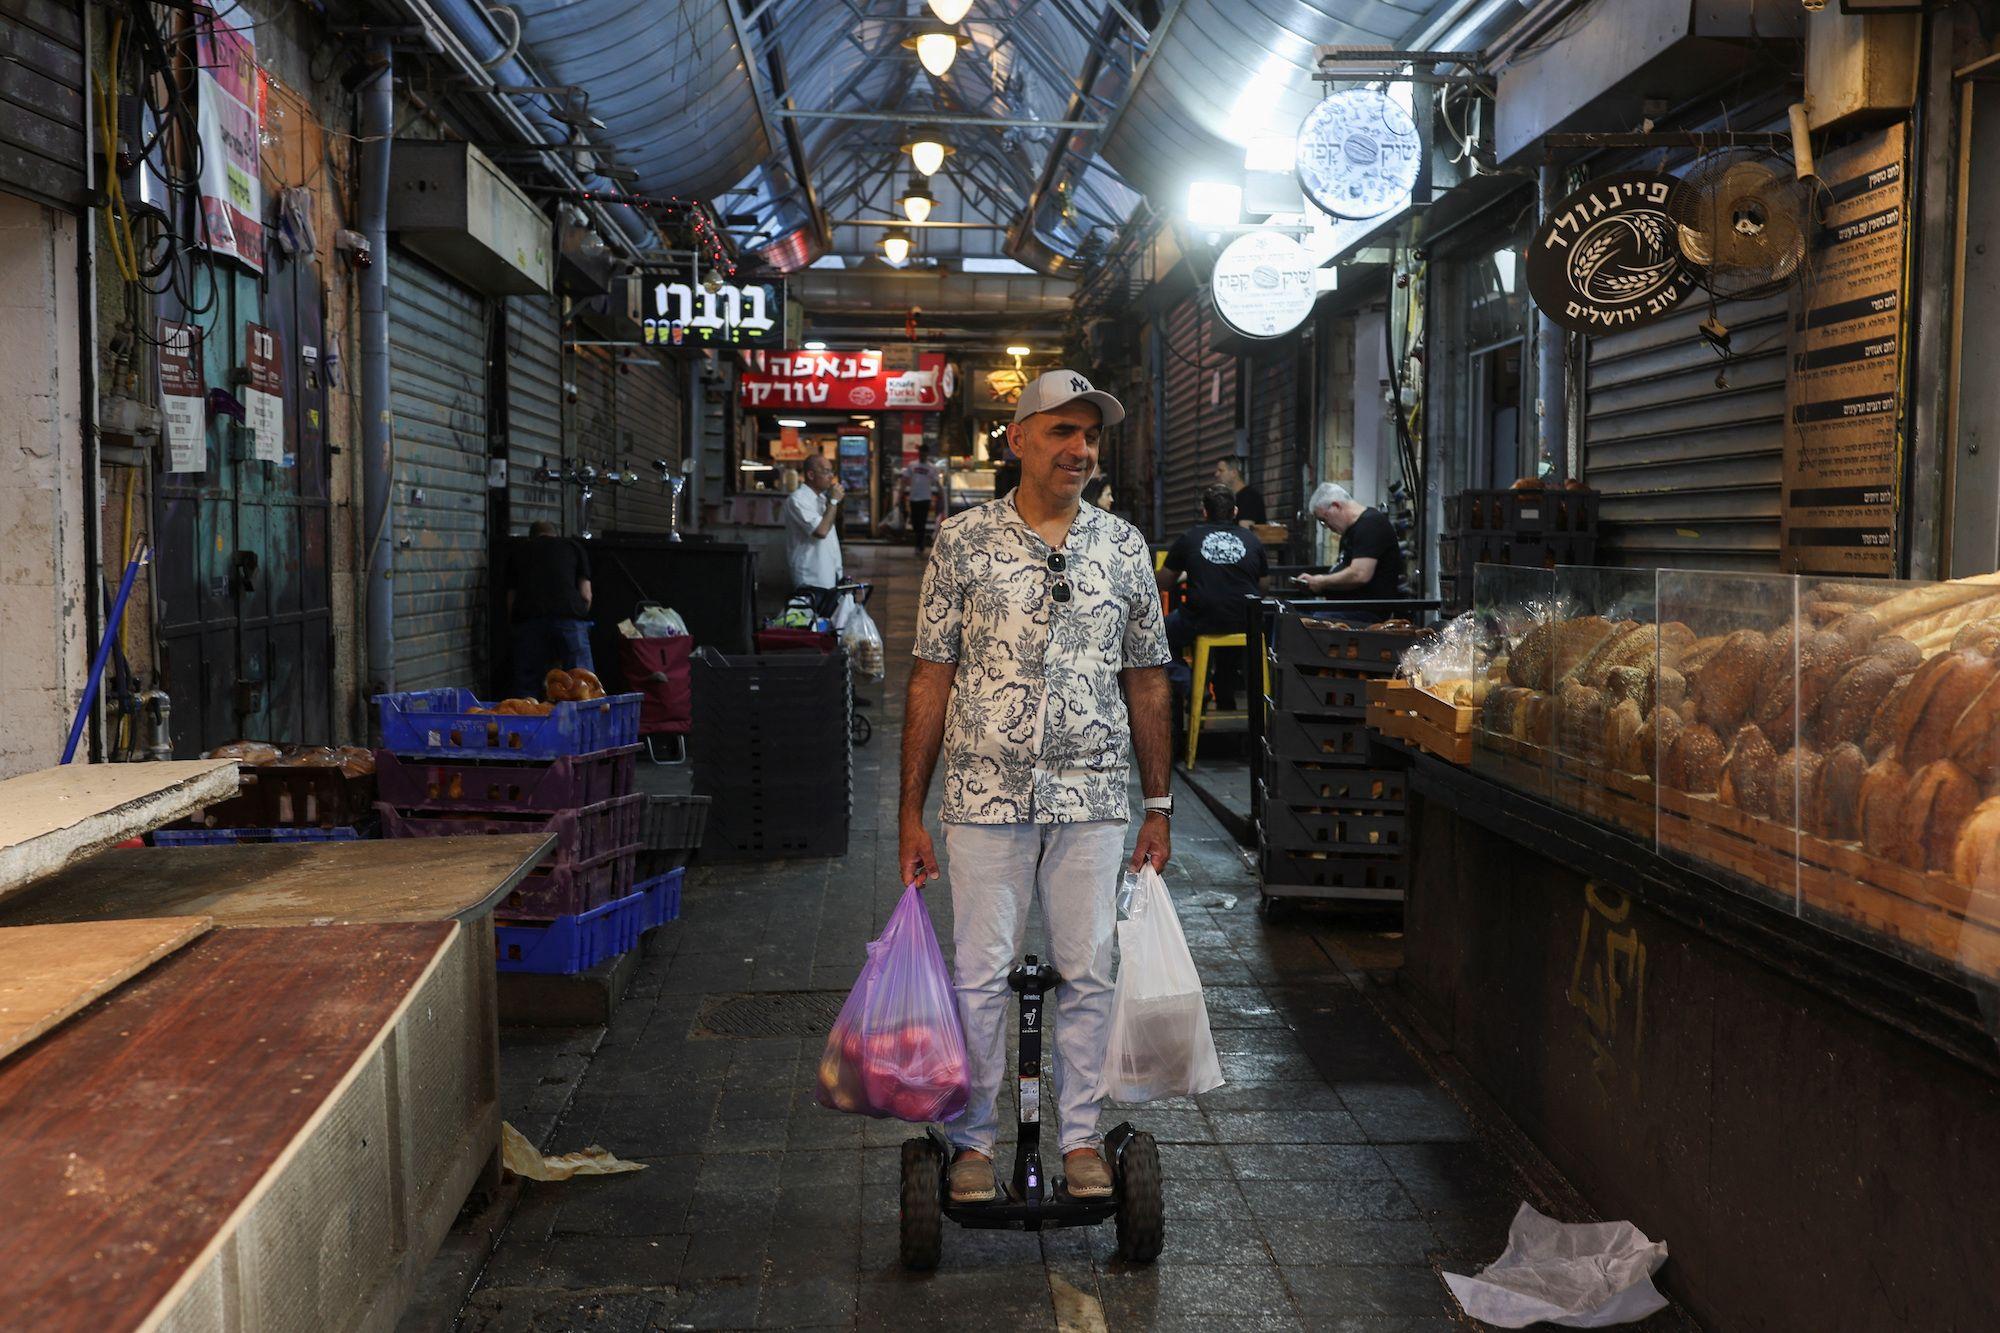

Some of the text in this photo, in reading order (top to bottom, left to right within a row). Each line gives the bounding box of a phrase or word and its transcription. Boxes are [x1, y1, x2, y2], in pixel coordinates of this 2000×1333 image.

[1544, 181, 1670, 250] פיינגולד
[1565, 285, 1678, 326] טוב ירושלים
[769, 355, 880, 378] כנאפה
[741, 380, 830, 405] טורקי
